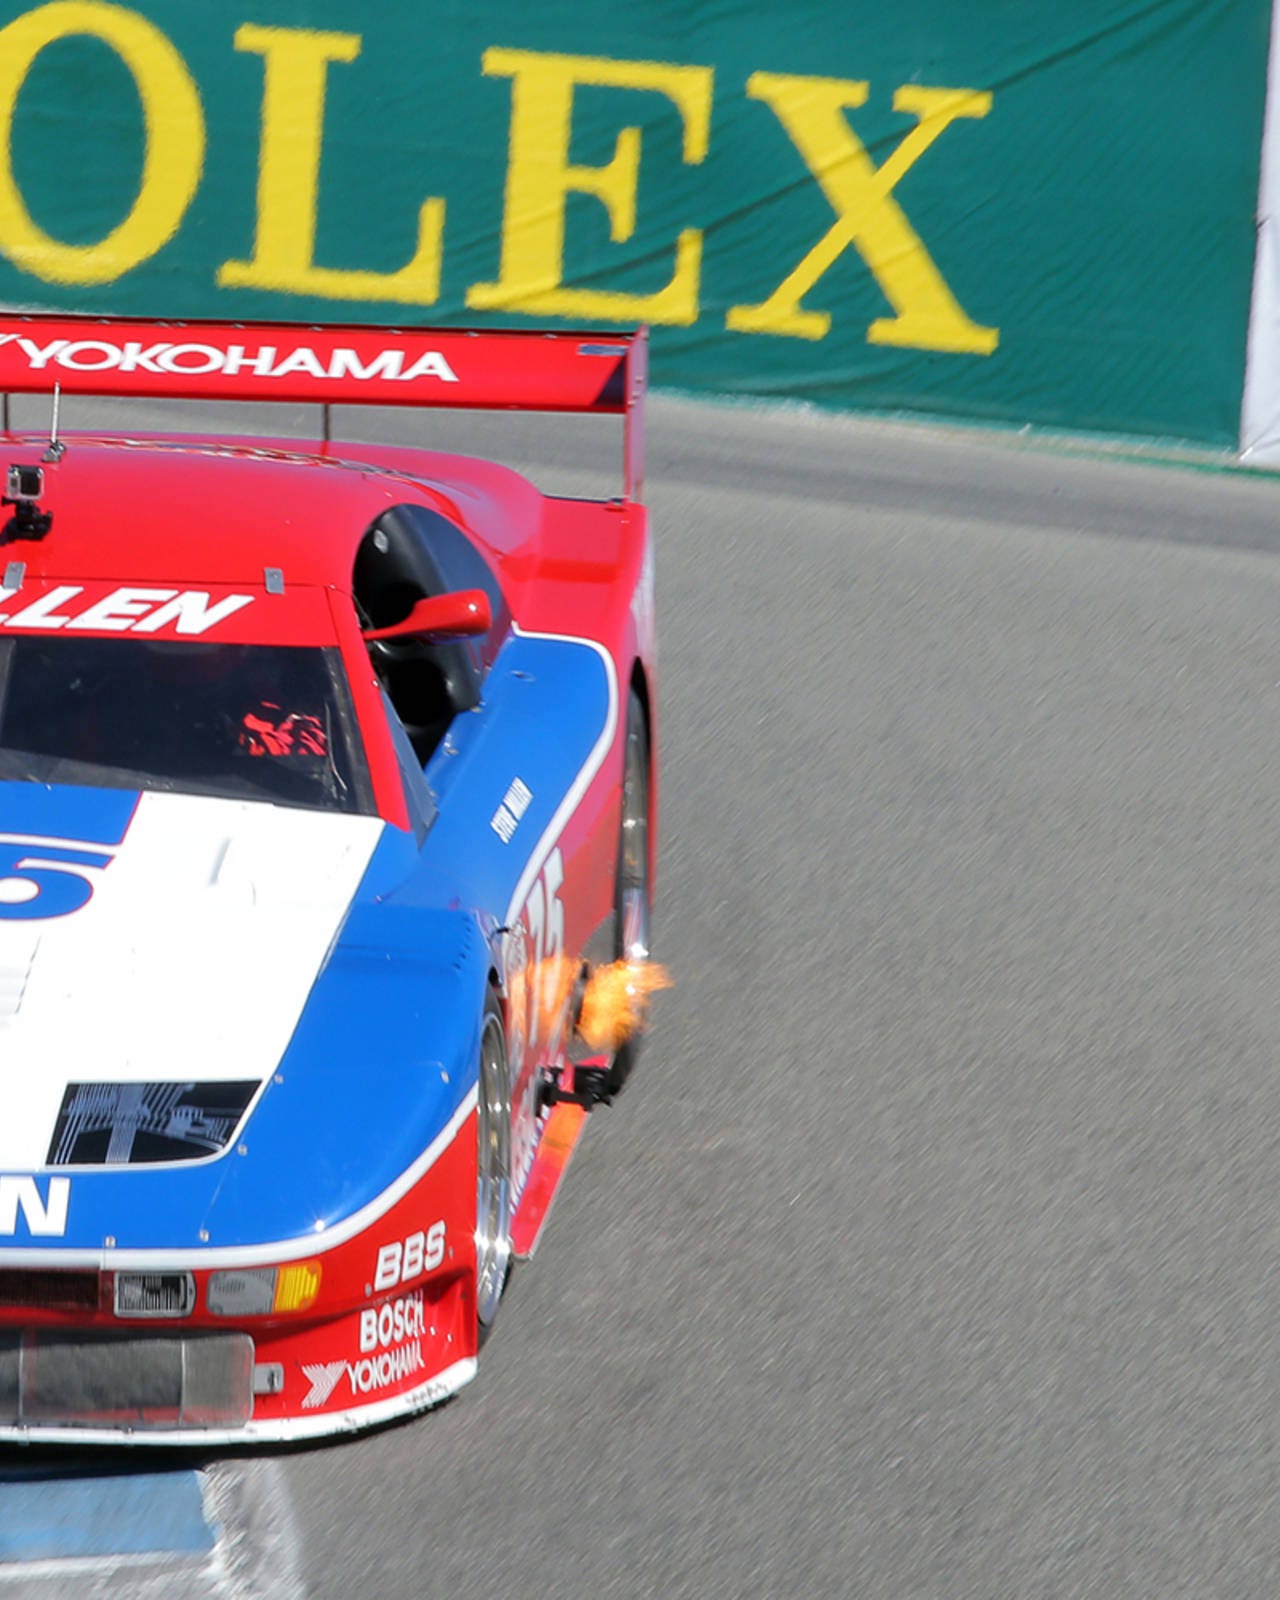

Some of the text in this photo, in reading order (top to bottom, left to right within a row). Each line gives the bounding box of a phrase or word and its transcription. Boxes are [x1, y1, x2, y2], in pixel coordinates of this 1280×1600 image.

[16, 338, 459, 381] YOKOHAMA
[373, 1219, 447, 1289] BBS
[359, 1289, 426, 1354] BOSCH
[346, 1340, 425, 1396] YOKOHAMA
